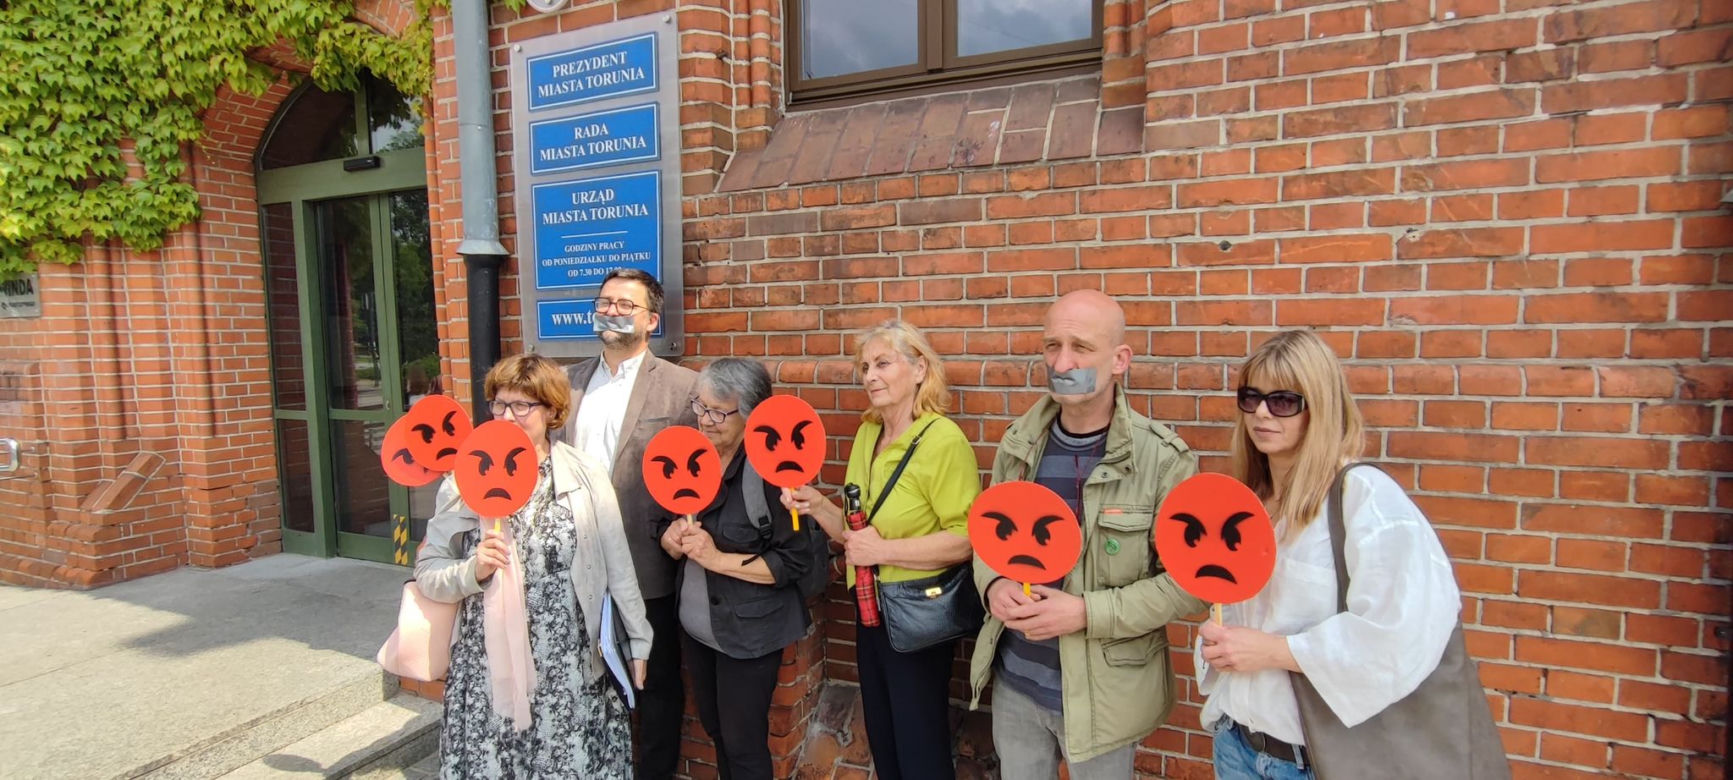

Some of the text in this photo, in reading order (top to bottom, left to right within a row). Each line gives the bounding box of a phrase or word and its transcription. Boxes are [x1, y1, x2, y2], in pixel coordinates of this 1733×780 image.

[553, 51, 627, 77] PREZYDENT
[538, 66, 644, 98] MIASTA TORUNIA
[574, 123, 608, 139] RADA
[540, 136, 646, 161] MIASTA TORUNIA
[572, 188, 614, 204] URZĄD
[543, 203, 648, 224] MIASTA TORUNIA
[564, 241, 625, 252] GODZINY PRACY
[542, 252, 651, 267] OD PONIEDZIAŁKU DO PIĄTKU
[567, 269, 578, 277] OD
[580, 268, 592, 277] 7.30
[593, 267, 604, 276] DO
